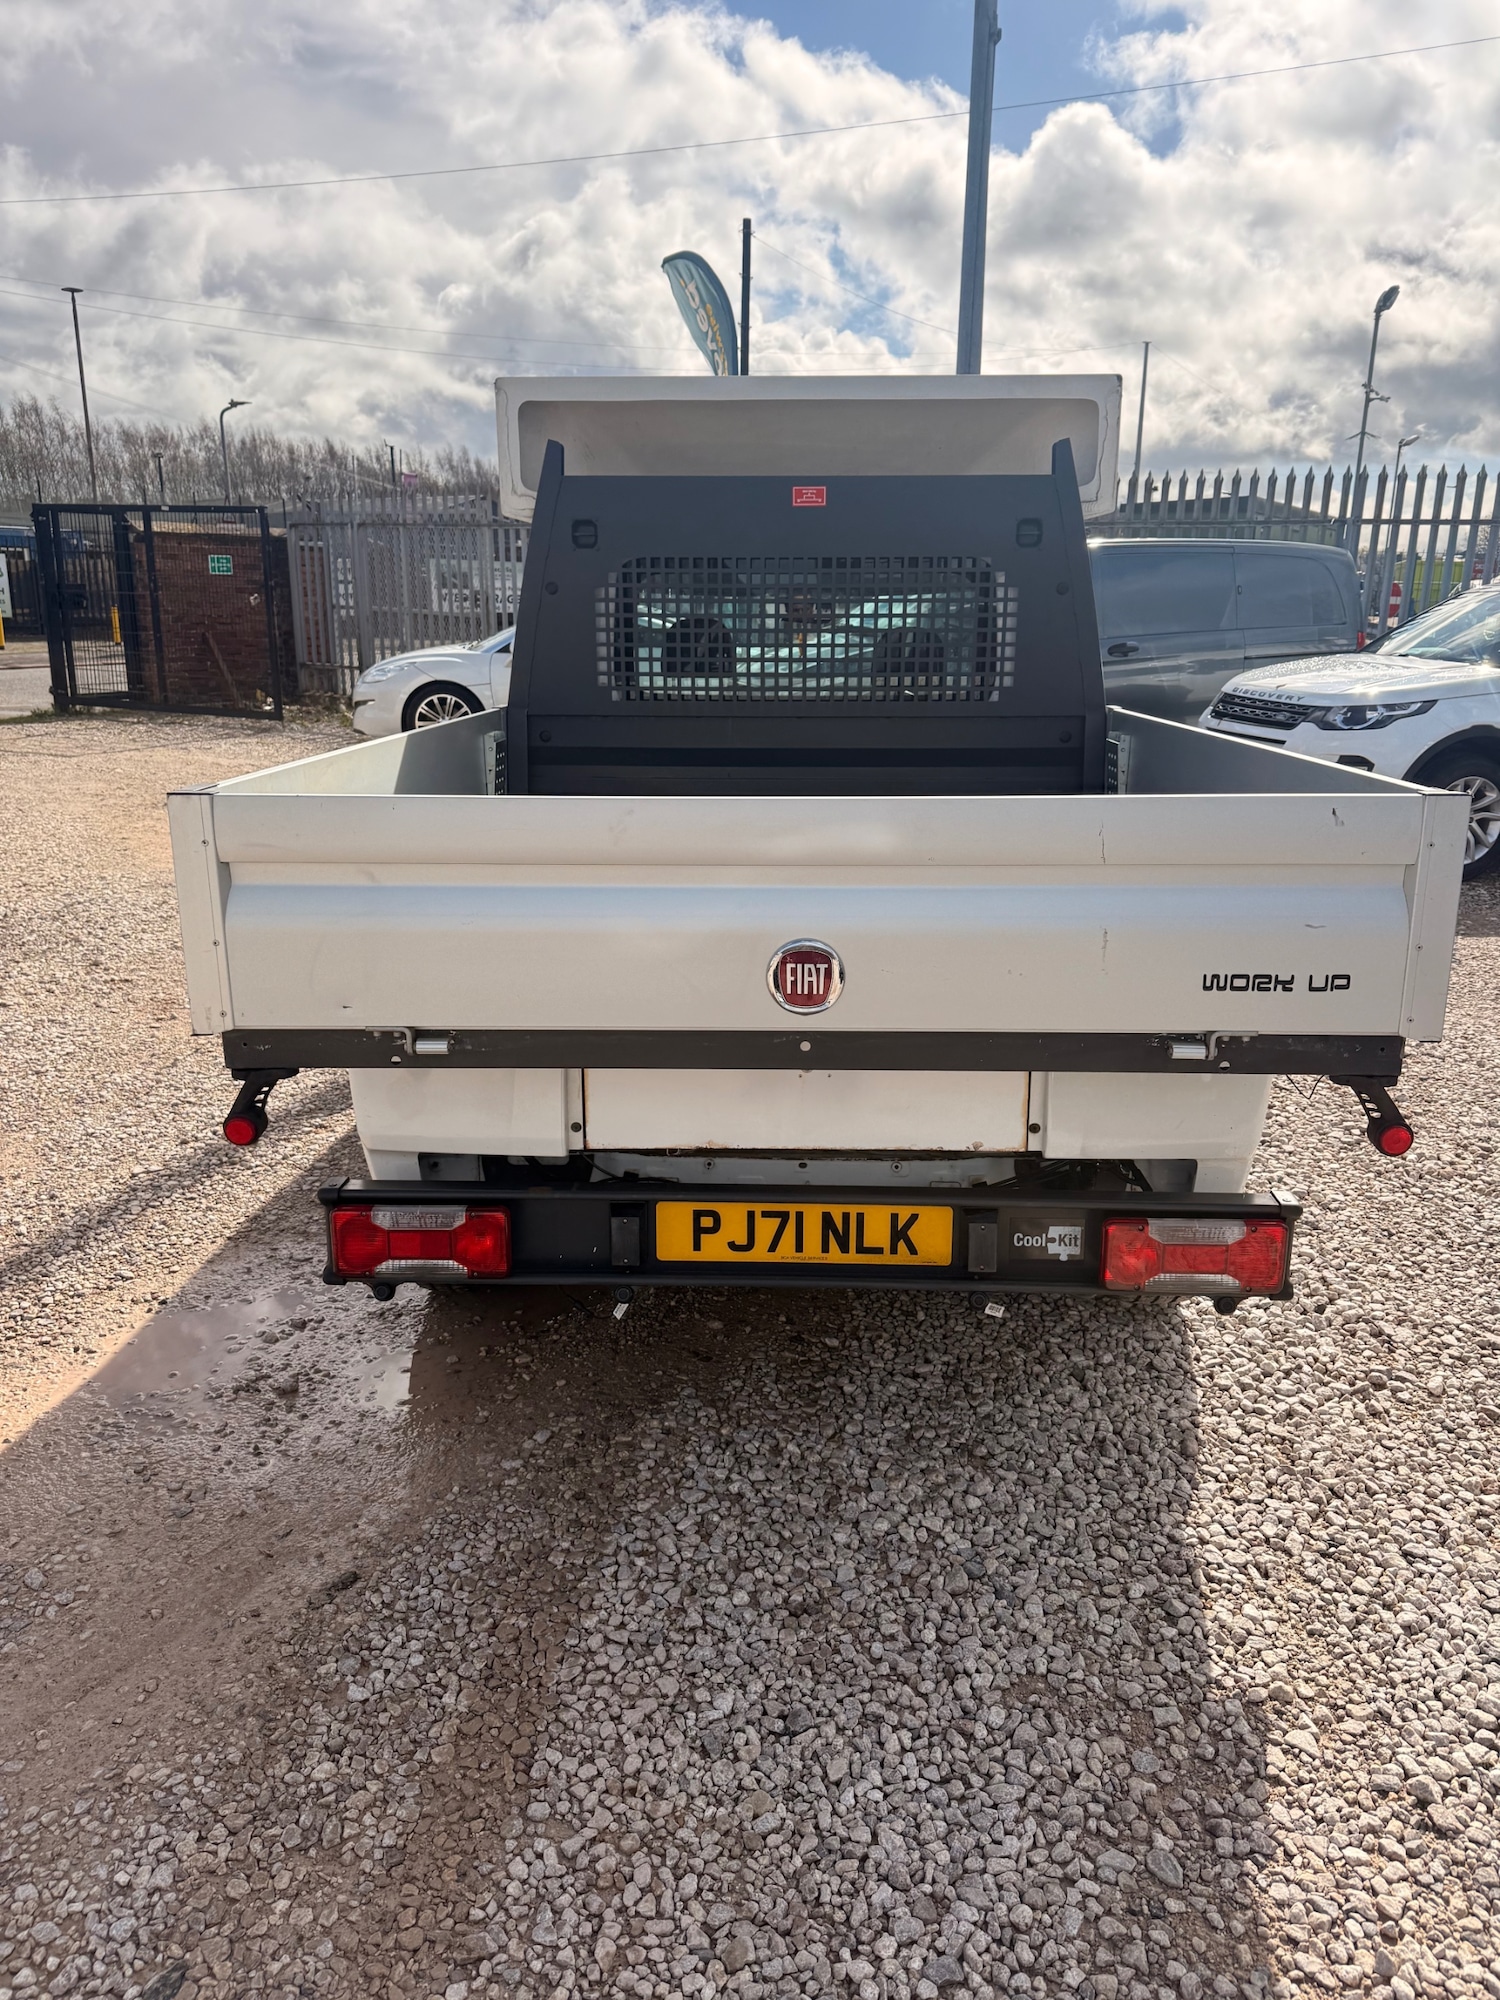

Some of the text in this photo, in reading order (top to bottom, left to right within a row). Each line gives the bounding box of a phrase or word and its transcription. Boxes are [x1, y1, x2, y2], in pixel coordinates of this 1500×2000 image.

[1232, 687, 1305, 702] DISCOVERY
[786, 963, 828, 995] FIAT
[1202, 973, 1351, 992] WORK UP
[692, 1209, 919, 1256] PJ71 NLK
[1013, 1232, 1080, 1248] Cool Kit
